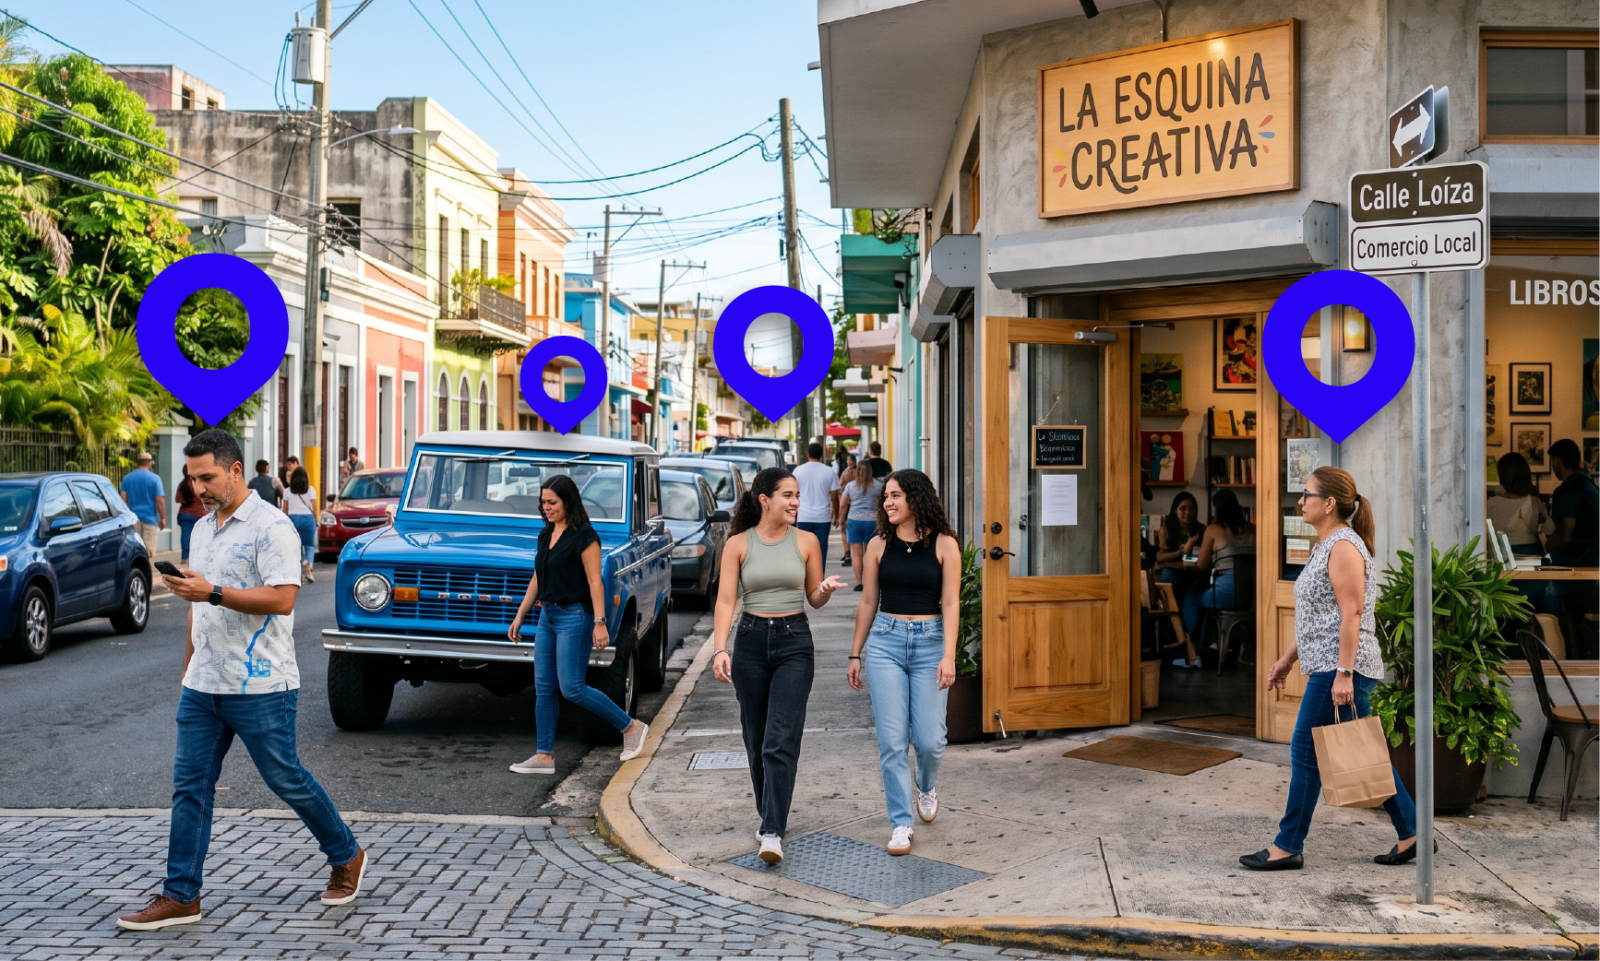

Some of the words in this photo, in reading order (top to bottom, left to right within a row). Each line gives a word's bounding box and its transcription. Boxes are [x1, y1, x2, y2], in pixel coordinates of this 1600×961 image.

[1060, 83, 1099, 133] LA
[1115, 52, 1271, 125] ESQUINA
[1071, 118, 1259, 195] CREATIVA
[1360, 182, 1410, 211] Calle
[1418, 176, 1474, 207] Loíza
[1357, 234, 1428, 259] Comercio
[1434, 231, 1476, 254] Local
[1510, 279, 1600, 306] LIBROS
